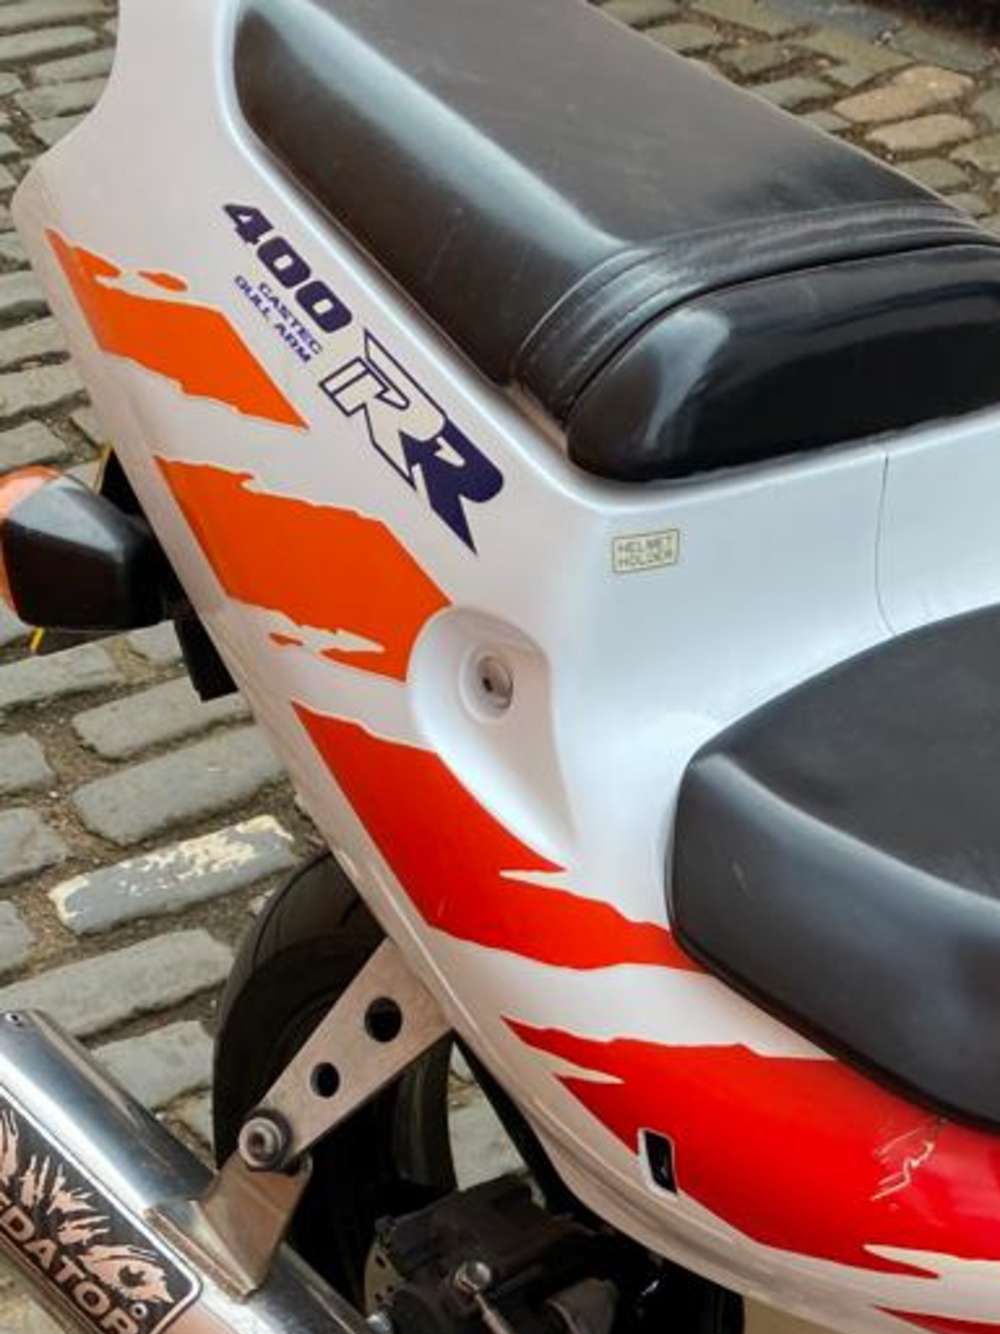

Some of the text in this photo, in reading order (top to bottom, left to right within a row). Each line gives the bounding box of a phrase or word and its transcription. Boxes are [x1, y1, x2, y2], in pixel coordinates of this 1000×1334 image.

[223, 203, 353, 334] 400
[258, 282, 323, 355] CASTEC
[274, 323, 312, 363] ARM
[318, 327, 504, 555] RR
[617, 536, 674, 553] HELMET
[617, 548, 674, 568] HOLDER
